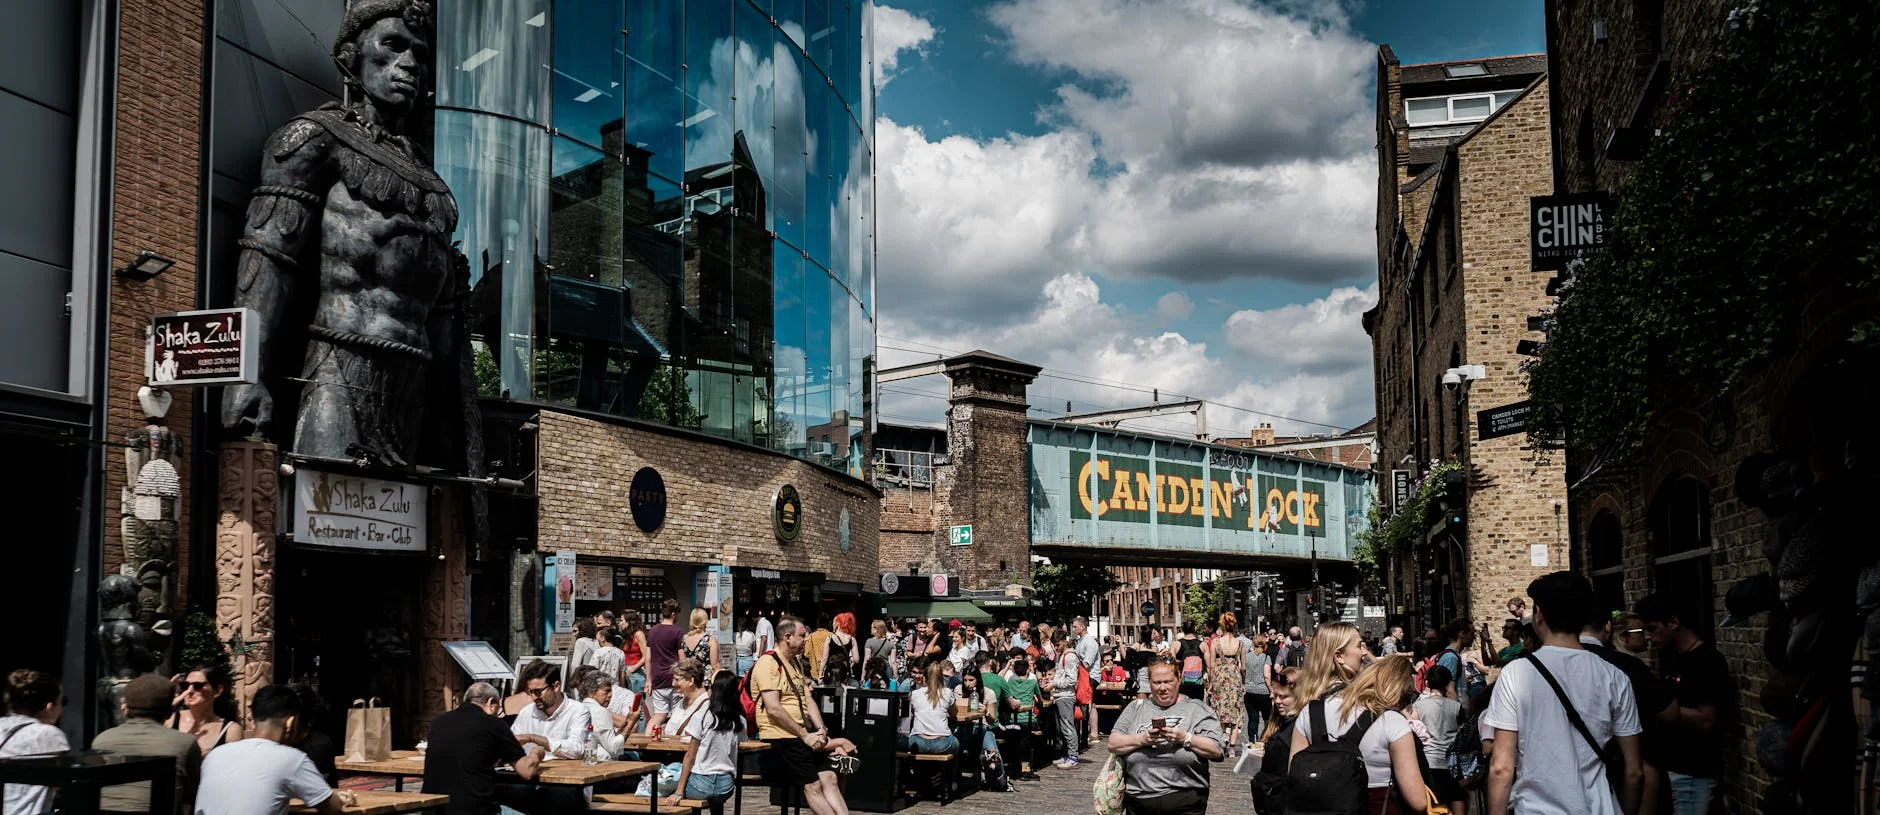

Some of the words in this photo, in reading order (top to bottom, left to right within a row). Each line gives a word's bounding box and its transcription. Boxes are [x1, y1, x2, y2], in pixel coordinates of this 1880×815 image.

[1595, 203, 1603, 244] LABS
[156, 322, 200, 347] Shaka
[204, 317, 240, 343] Zulu
[1491, 410, 1512, 420] CAMDEN
[1497, 417, 1514, 425] TOILETS
[333, 480, 376, 512] Shaka
[380, 485, 410, 513] Zulu
[1077, 459, 1233, 519] CAMDEN
[1246, 478, 1320, 529] LOCK
[308, 516, 360, 539] Restaurant
[368, 522, 387, 541] Bar
[391, 527, 412, 545] Club
